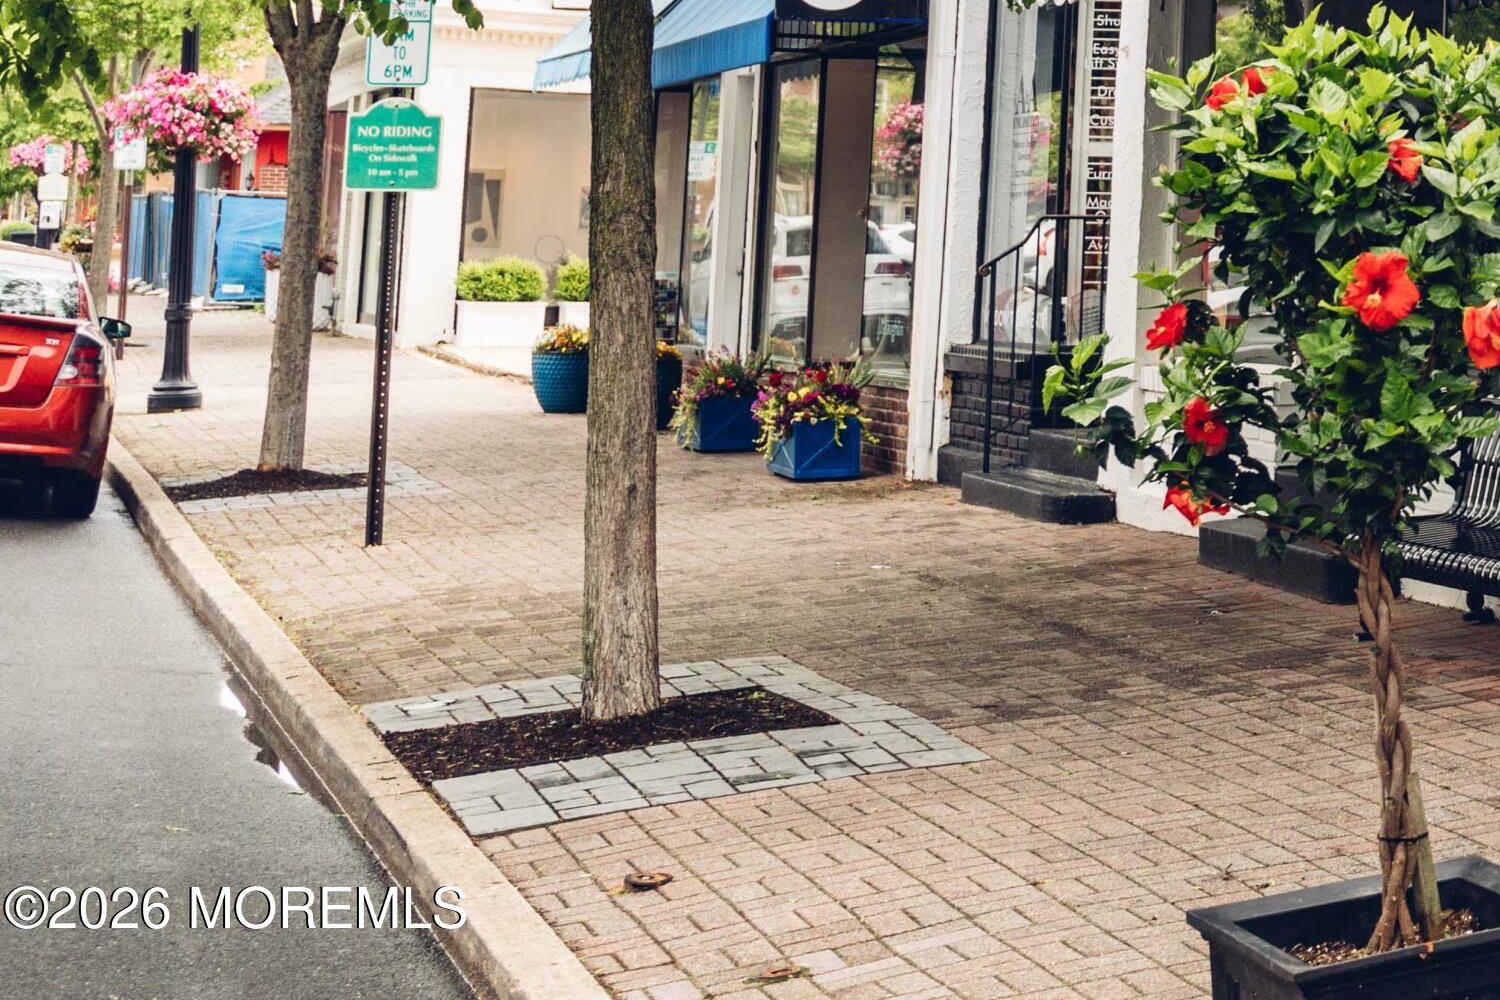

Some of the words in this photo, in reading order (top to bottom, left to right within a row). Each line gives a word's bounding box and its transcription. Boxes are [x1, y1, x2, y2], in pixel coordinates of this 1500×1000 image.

[393, 46, 407, 60] TO
[384, 65, 413, 78] 6PM
[357, 125, 380, 137] NO
[383, 125, 433, 138] RIDING
[368, 154, 382, 163] On
[383, 153, 418, 163] Sidewalk
[368, 168, 378, 177] 10
